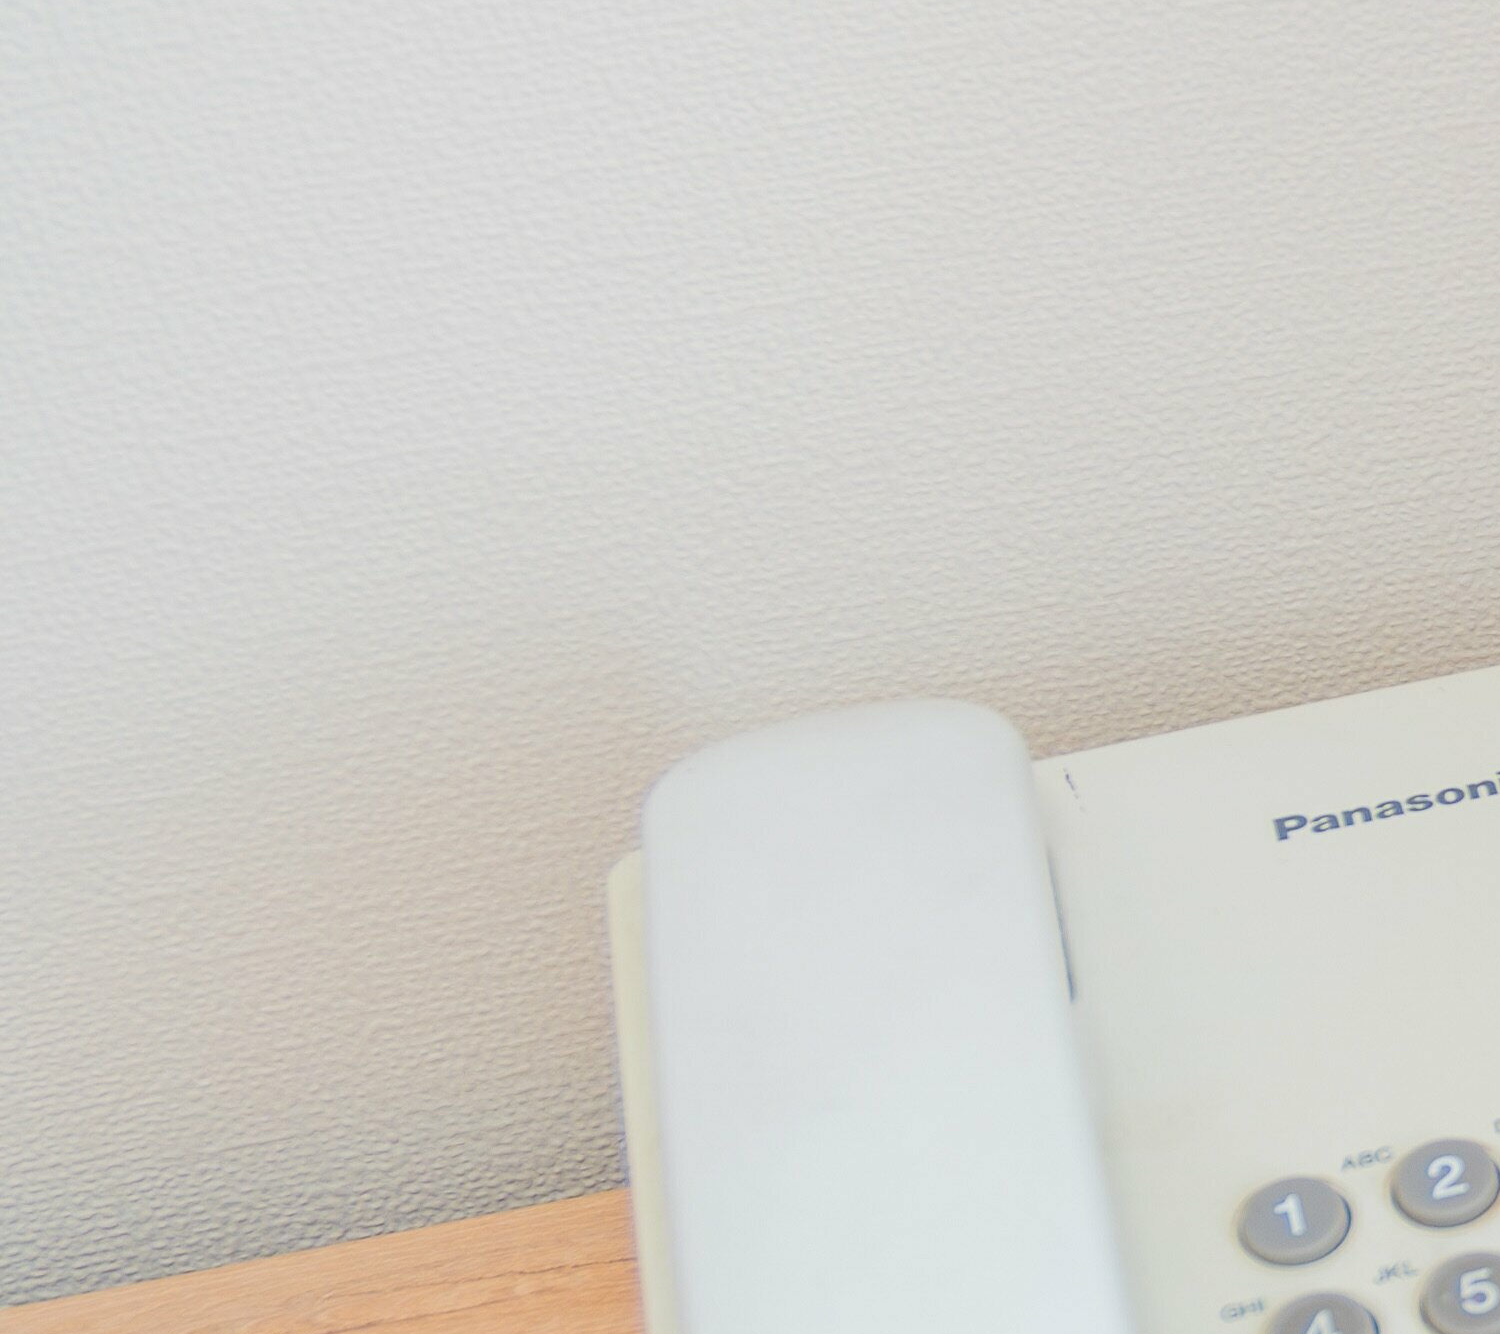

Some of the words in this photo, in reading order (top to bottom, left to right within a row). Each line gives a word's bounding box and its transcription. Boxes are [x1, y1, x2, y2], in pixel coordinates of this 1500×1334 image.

[1340, 1145, 1393, 1171] ABC
[1426, 1154, 1471, 1201] 2
[1273, 1193, 1307, 1236] 1
[1458, 1267, 1500, 1315] 5
